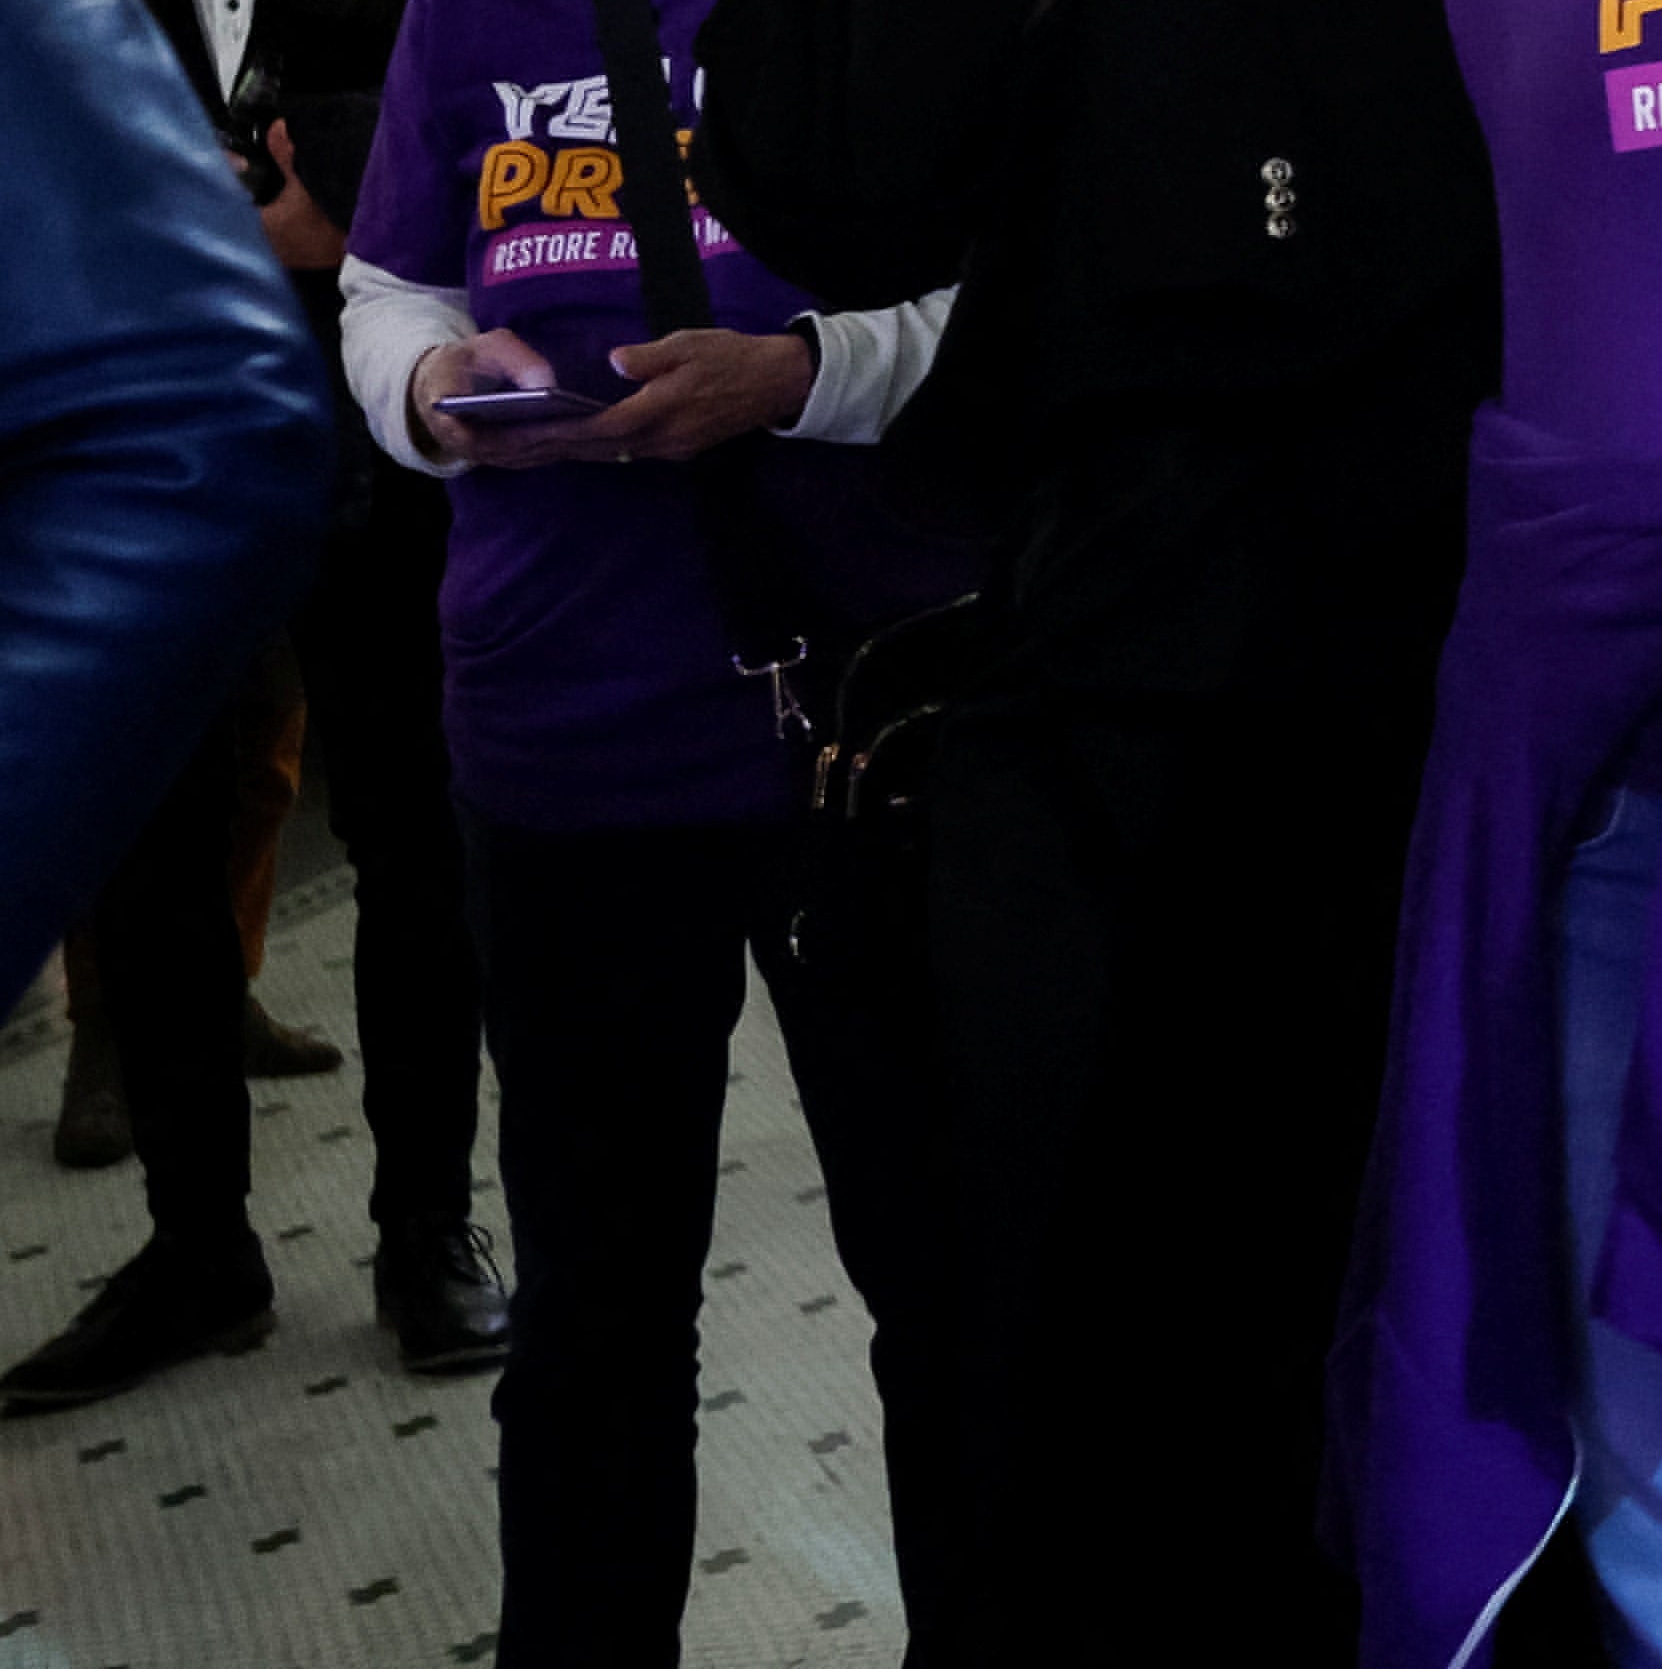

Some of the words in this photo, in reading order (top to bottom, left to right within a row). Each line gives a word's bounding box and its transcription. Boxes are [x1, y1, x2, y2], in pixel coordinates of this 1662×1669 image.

[492, 74, 616, 144] YE
[478, 139, 624, 230] PR
[493, 232, 601, 273] RESTORE
